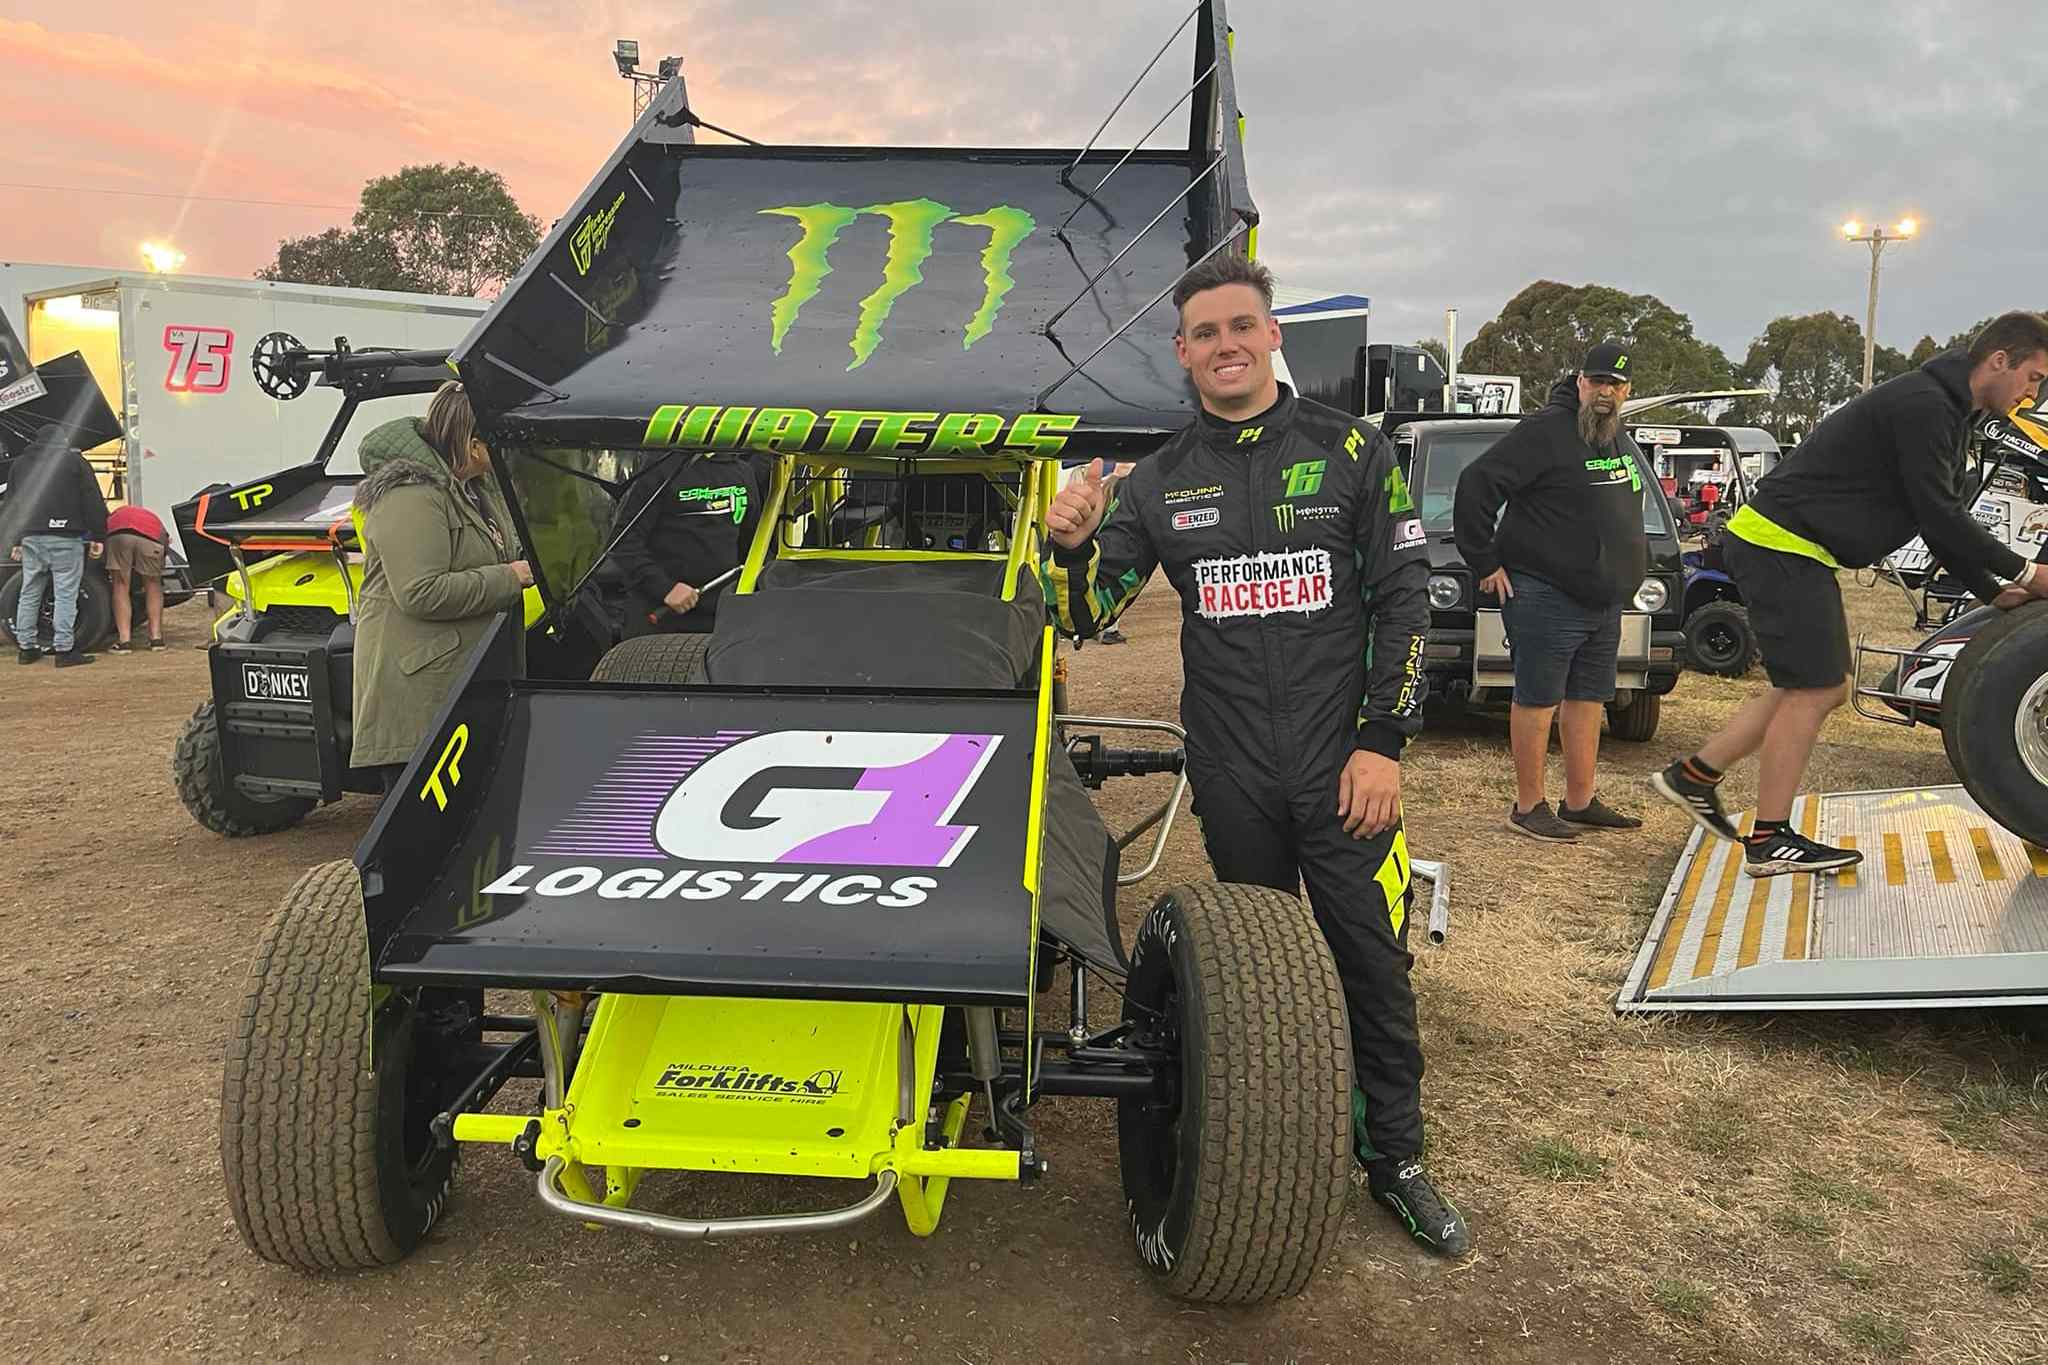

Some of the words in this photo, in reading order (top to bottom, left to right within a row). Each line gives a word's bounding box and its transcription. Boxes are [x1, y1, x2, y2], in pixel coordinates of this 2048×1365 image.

[165, 326, 233, 392] 75
[1615, 356, 1628, 369] 6
[641, 405, 1080, 457] WATERS
[229, 483, 273, 511] TP
[1295, 506, 1340, 516] MONSTER
[1200, 554, 1325, 585] PERFORMANCE
[1202, 574, 1327, 612] RACEGEAR
[248, 671, 309, 697] DNKEY
[420, 723, 469, 812] TP
[654, 730, 1005, 868] G1
[479, 864, 939, 908] LOGISTICS
[656, 1070, 799, 1093] Forklifts
[667, 1063, 750, 1073] MILDURA
[655, 1091, 708, 1099] SALES
[715, 1093, 783, 1103] SERVICE
